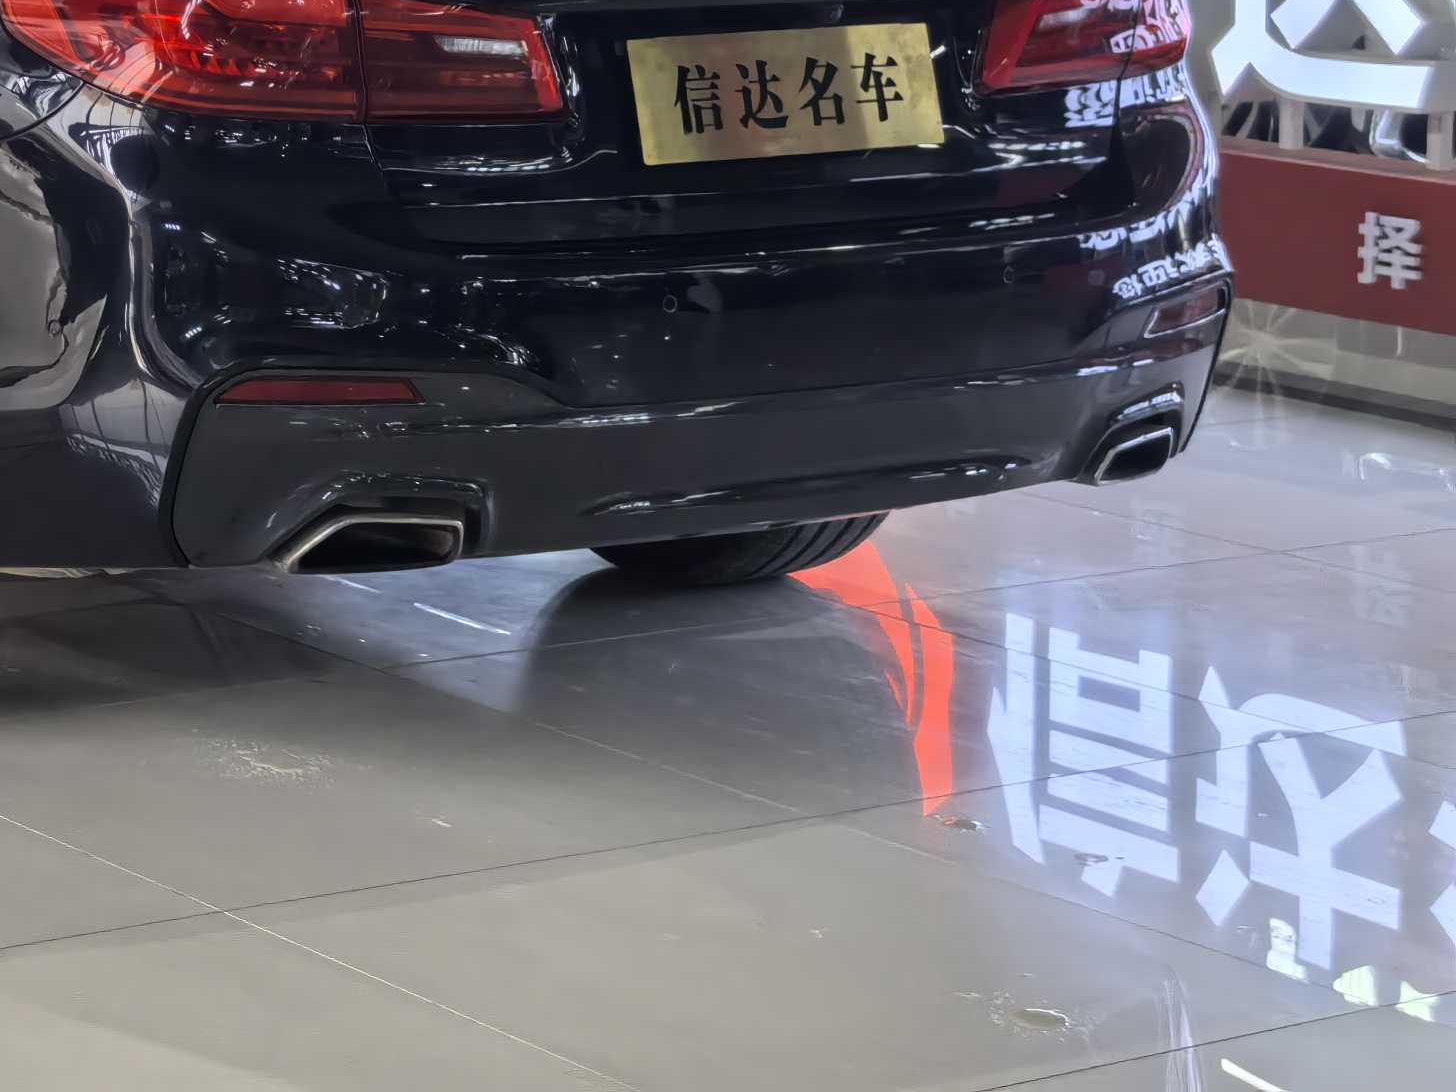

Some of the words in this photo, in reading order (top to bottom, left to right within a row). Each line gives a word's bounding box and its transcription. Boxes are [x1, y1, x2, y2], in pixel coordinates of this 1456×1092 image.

[674, 52, 903, 135] 信达名车
[1356, 211, 1424, 290] 择
